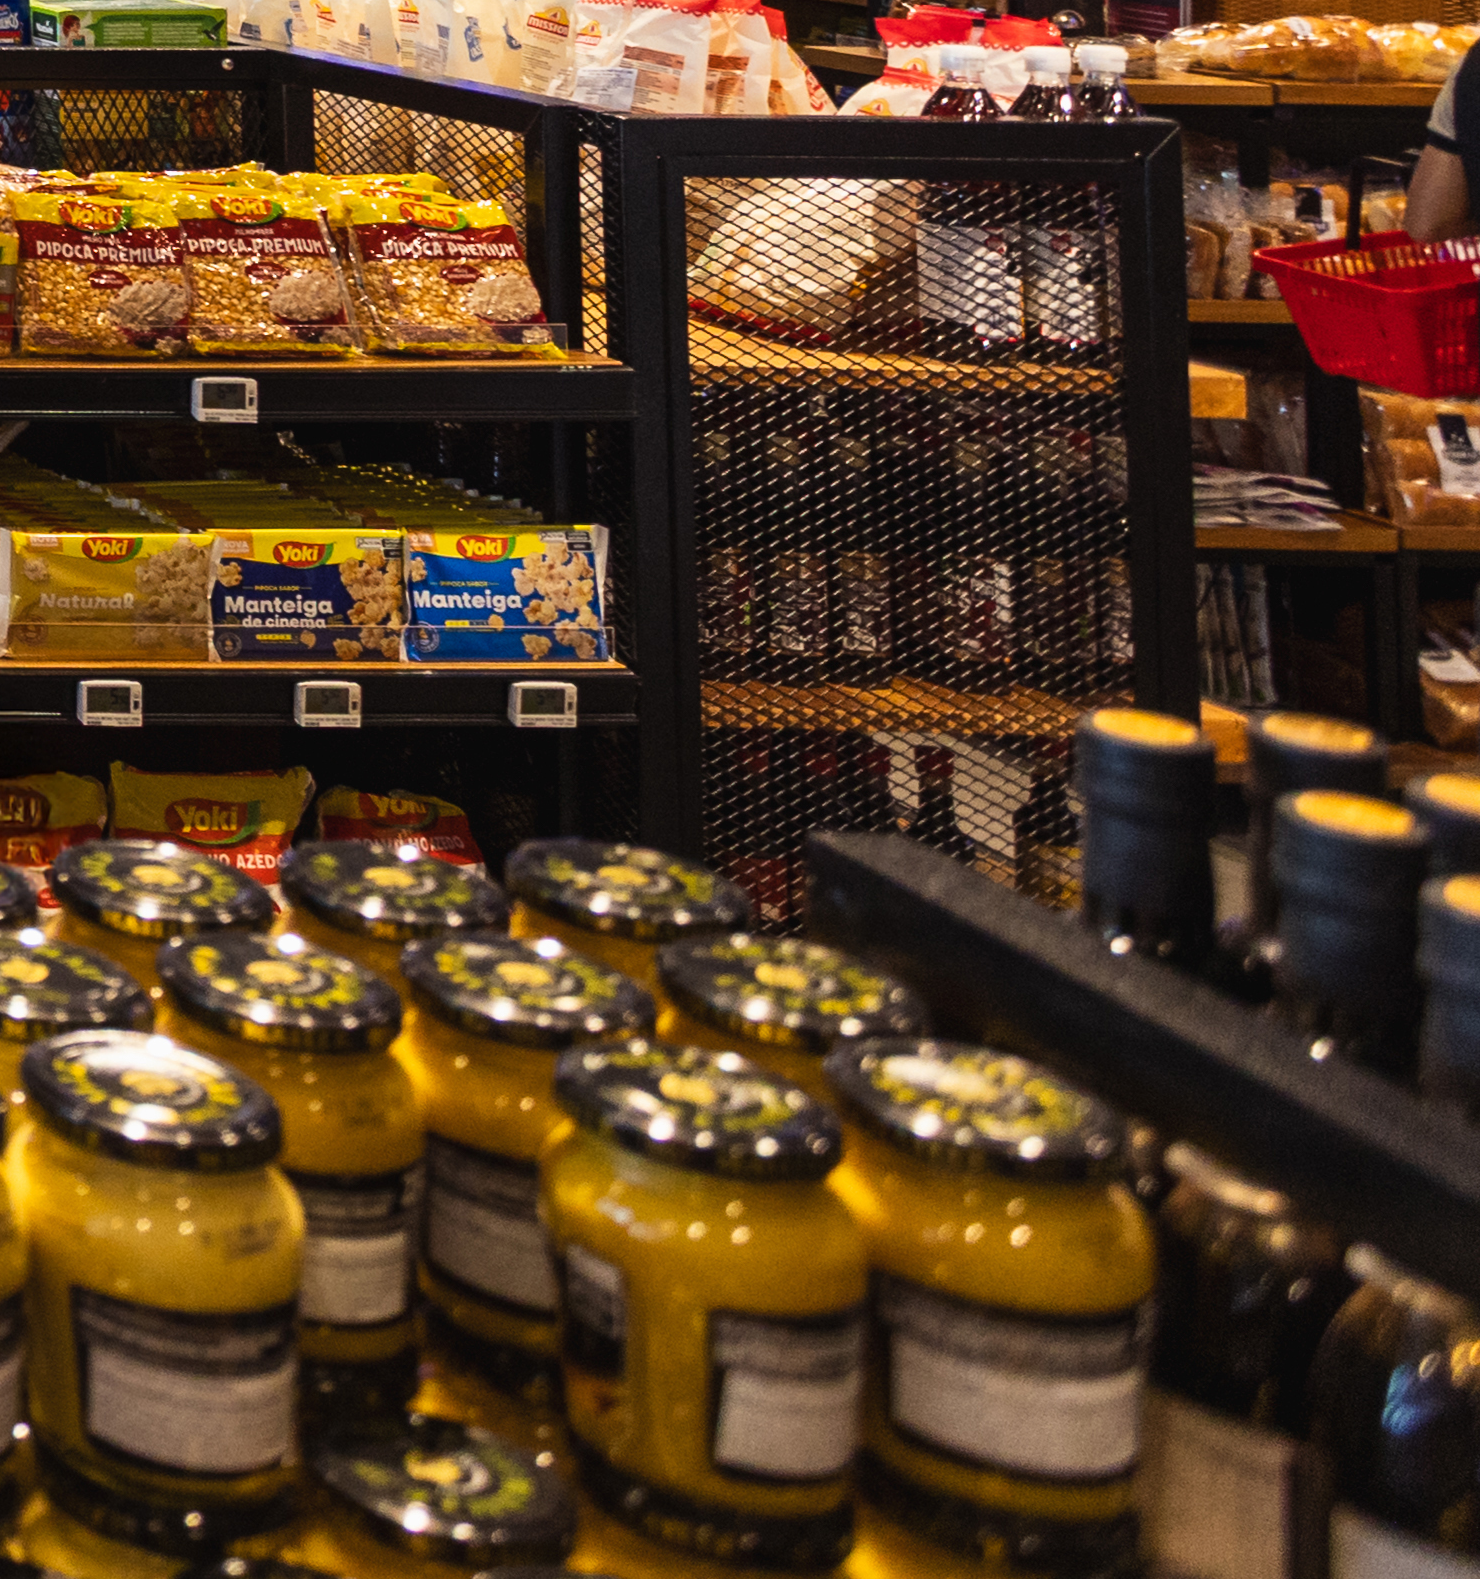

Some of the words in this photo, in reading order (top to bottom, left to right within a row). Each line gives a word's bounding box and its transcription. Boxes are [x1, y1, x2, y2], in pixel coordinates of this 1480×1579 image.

[35, 238, 96, 259] PIPOCA
[102, 244, 178, 265] PREMIUM
[280, 543, 322, 565] Yoki
[40, 591, 134, 611] Natural
[224, 596, 333, 617] Manteiga
[414, 590, 522, 611] Manteiga
[242, 615, 260, 629] de
[263, 615, 326, 629] cinema
